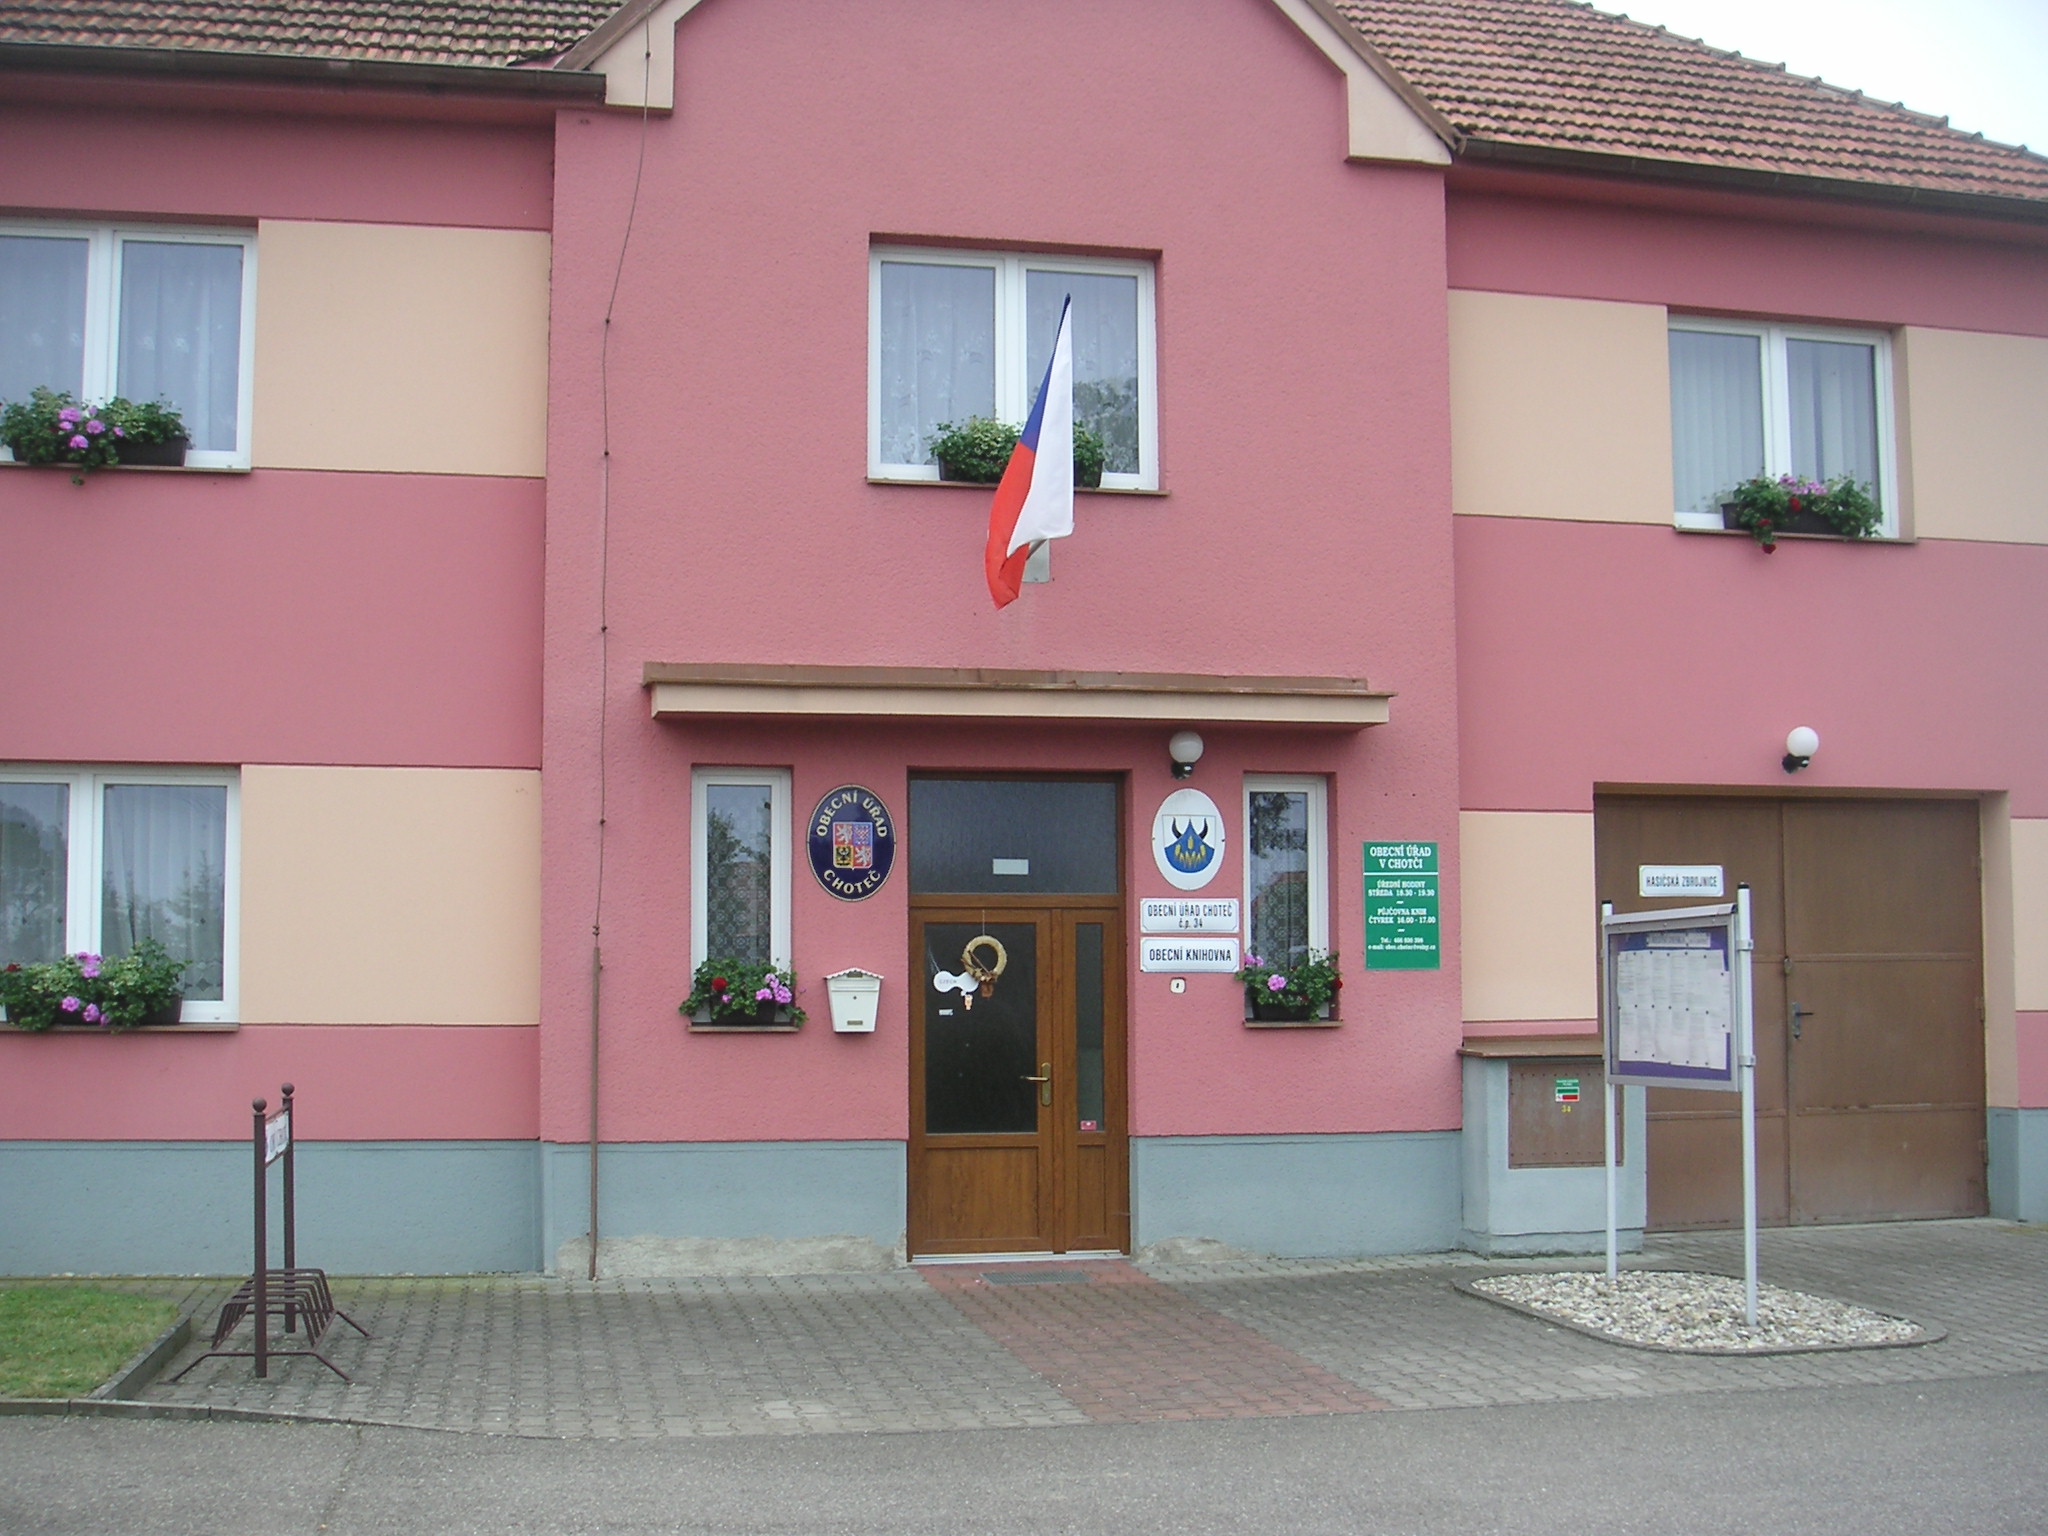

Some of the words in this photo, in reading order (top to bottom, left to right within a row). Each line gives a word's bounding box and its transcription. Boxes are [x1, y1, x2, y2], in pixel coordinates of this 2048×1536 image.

[816, 790, 858, 837] OBECNÍ
[862, 797, 888, 837] ÚŘAD
[1369, 844, 1404, 857] OBECNÍ
[1406, 844, 1432, 857] ÚŘAD
[1379, 858, 1386, 869] V
[1388, 857, 1423, 869] CHOTČI
[823, 869, 881, 894] CHOTEČ
[1377, 879, 1401, 889] ÚŘEDNÍ
[1402, 880, 1426, 889] HODINY
[1646, 874, 1679, 887] HASIČSKÁ
[1682, 875, 1717, 887] ZBROJNICE
[1368, 888, 1394, 897] STŘEDA
[1147, 902, 1177, 917] OBECNÍ
[1179, 902, 1201, 917] ÚŘAD
[1203, 902, 1233, 917] CHOTEČ
[1377, 906, 1410, 916] PŮJČOVNA
[1178, 918, 1191, 930] č.p.
[1193, 918, 1203, 928] 34
[1419, 916, 1436, 924] 17.00
[1149, 945, 1183, 961] OBECNÍ
[1186, 948, 1232, 961] KNIHOVNA
